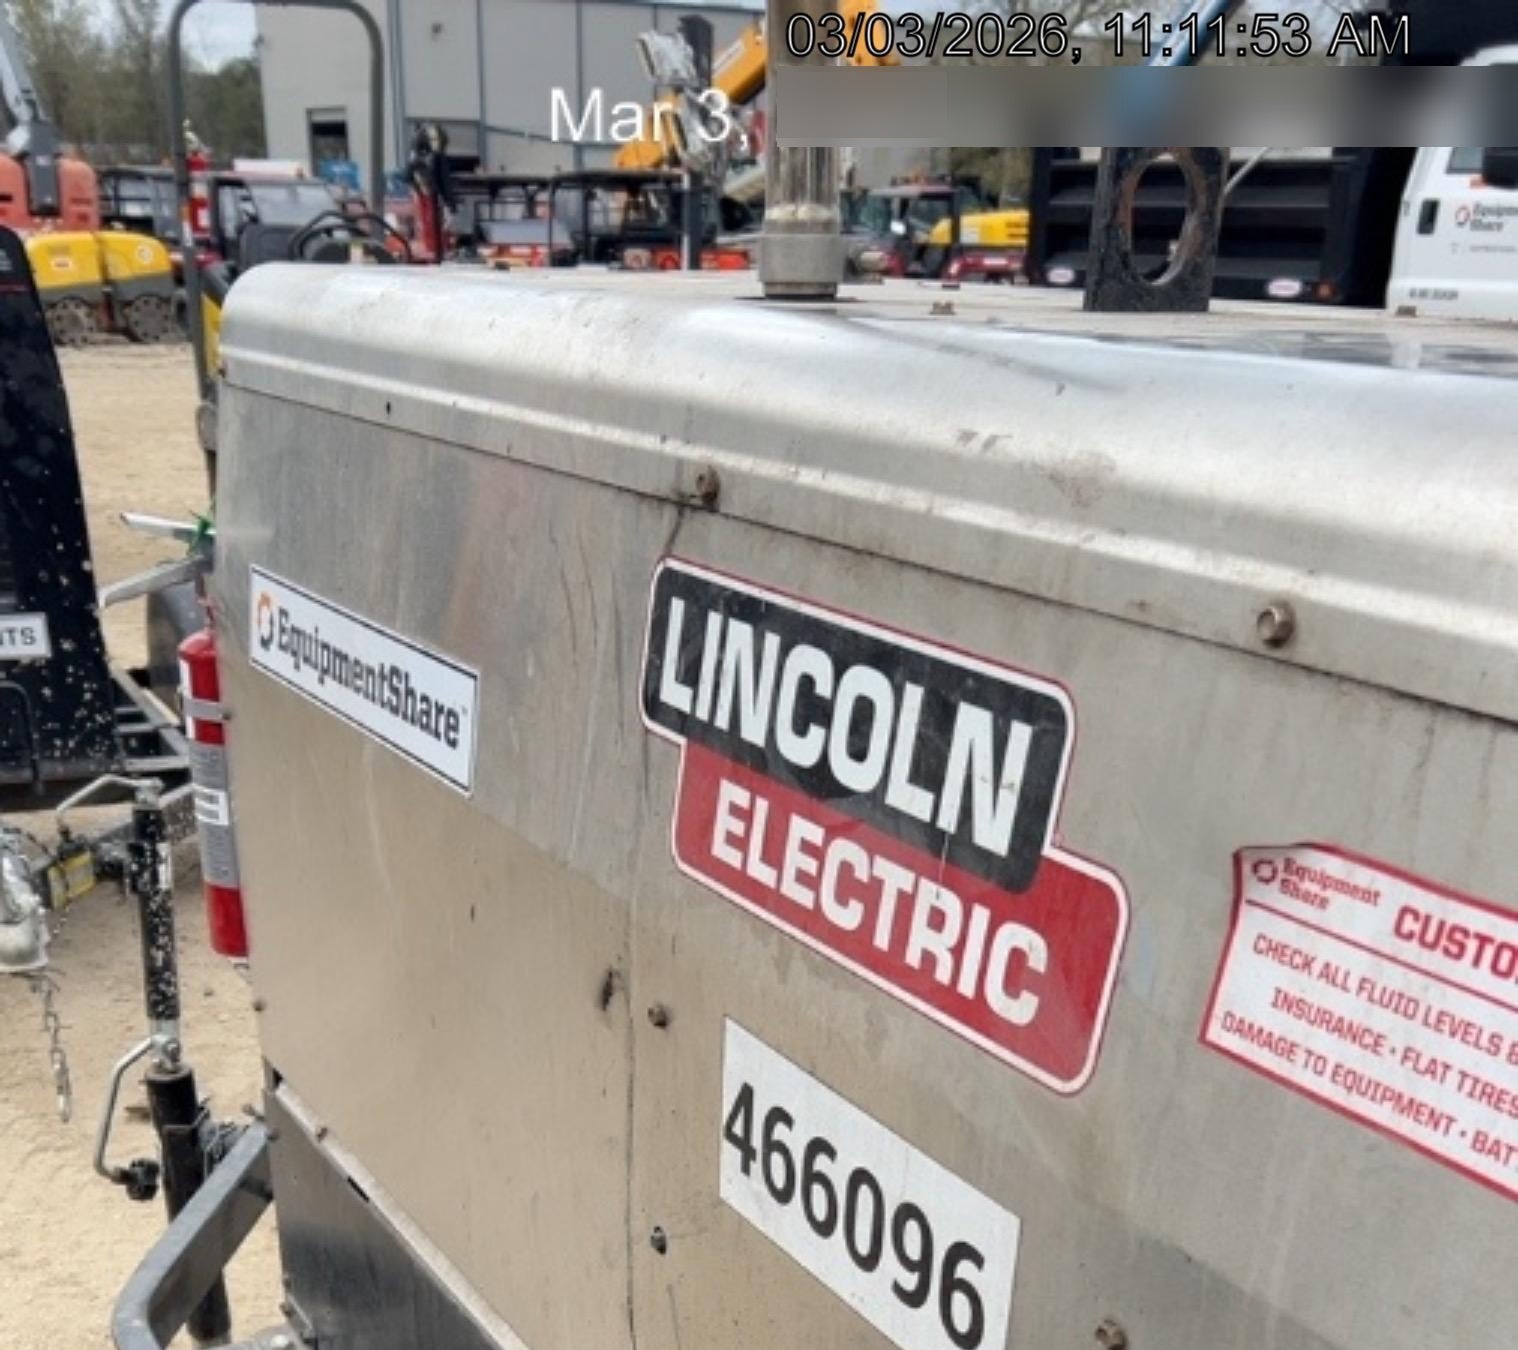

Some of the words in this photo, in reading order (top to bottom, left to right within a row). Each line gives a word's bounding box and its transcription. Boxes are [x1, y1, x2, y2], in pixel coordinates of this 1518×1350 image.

[0, 626, 37, 647] TS
[278, 606, 460, 750] EquipmentShare
[659, 597, 1033, 858] LINCOLN
[711, 778, 1048, 1026] ELECTRIC
[1280, 878, 1330, 910] Share
[1283, 857, 1381, 907] Equipment
[1253, 934, 1317, 977] CHECK
[1317, 960, 1352, 994] ALL
[1355, 976, 1421, 1022] FLUID
[1422, 1005, 1504, 1057] LEVELS
[1393, 905, 1518, 986] CUSTO
[1221, 1010, 1300, 1064] DAMAGE
[1303, 1050, 1329, 1076] TO
[1330, 1063, 1457, 1137] EQUIPMENT
[1270, 986, 1388, 1057] INSURANCE
[1400, 1045, 1452, 1085] FLAT
